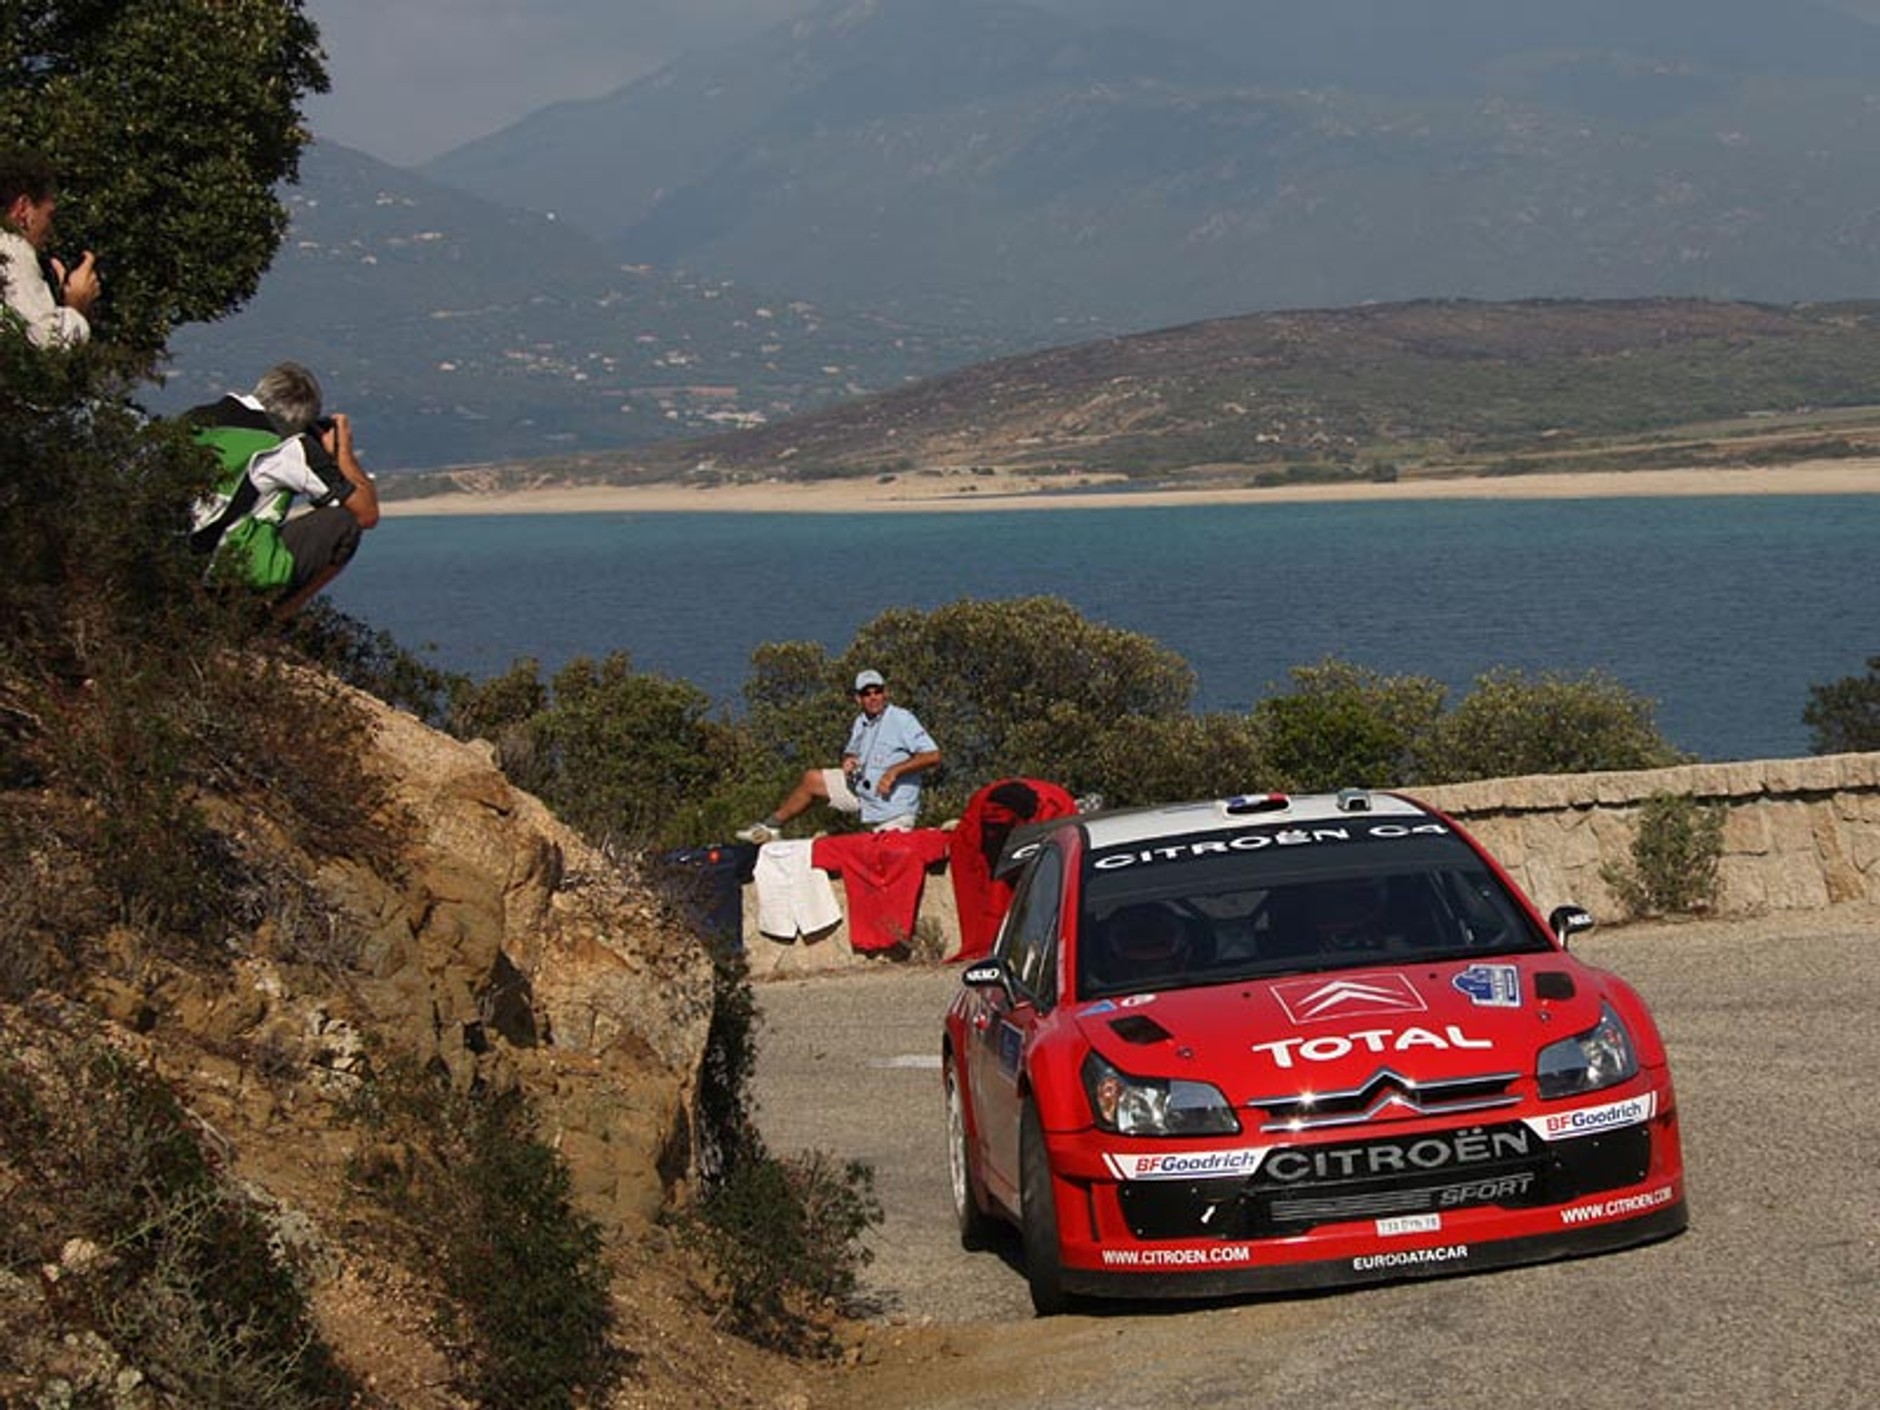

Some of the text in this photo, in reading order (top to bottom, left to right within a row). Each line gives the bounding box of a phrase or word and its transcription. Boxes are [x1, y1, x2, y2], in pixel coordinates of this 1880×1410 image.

[1094, 823, 1449, 869] CITROËN C4
[1252, 1026, 1494, 1068] TOTAL
[1545, 1102, 1642, 1131] BFGoodrich
[1136, 1152, 1256, 1172] BFGoodrich
[1265, 1127, 1529, 1181] CITROËN
[1439, 1174, 1535, 1206] SPORT
[1102, 1247, 1250, 1265] WWW.CITROEN.COM
[1353, 1245, 1468, 1270] EURODATACAR
